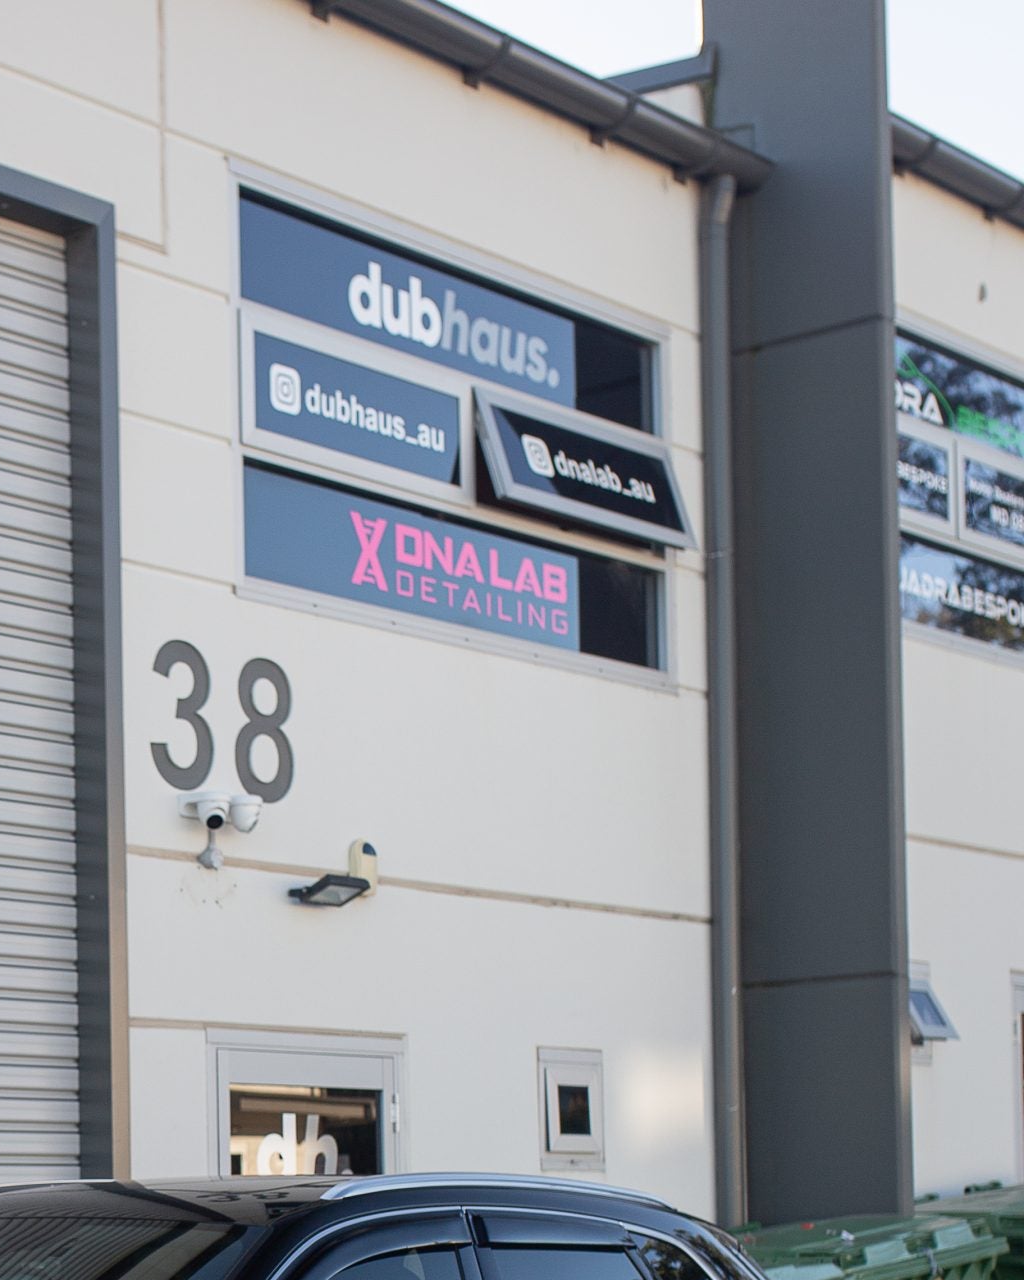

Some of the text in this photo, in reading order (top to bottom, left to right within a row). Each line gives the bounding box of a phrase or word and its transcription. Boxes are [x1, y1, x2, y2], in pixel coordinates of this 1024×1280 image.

[348, 261, 561, 390] dubhaus.
[305, 383, 447, 454] dubhaus_au
[553, 450, 657, 505] dnalab_au
[394, 523, 569, 604] DNA LAB
[395, 570, 569, 636] DETAILING
[149, 639, 294, 804] 38
